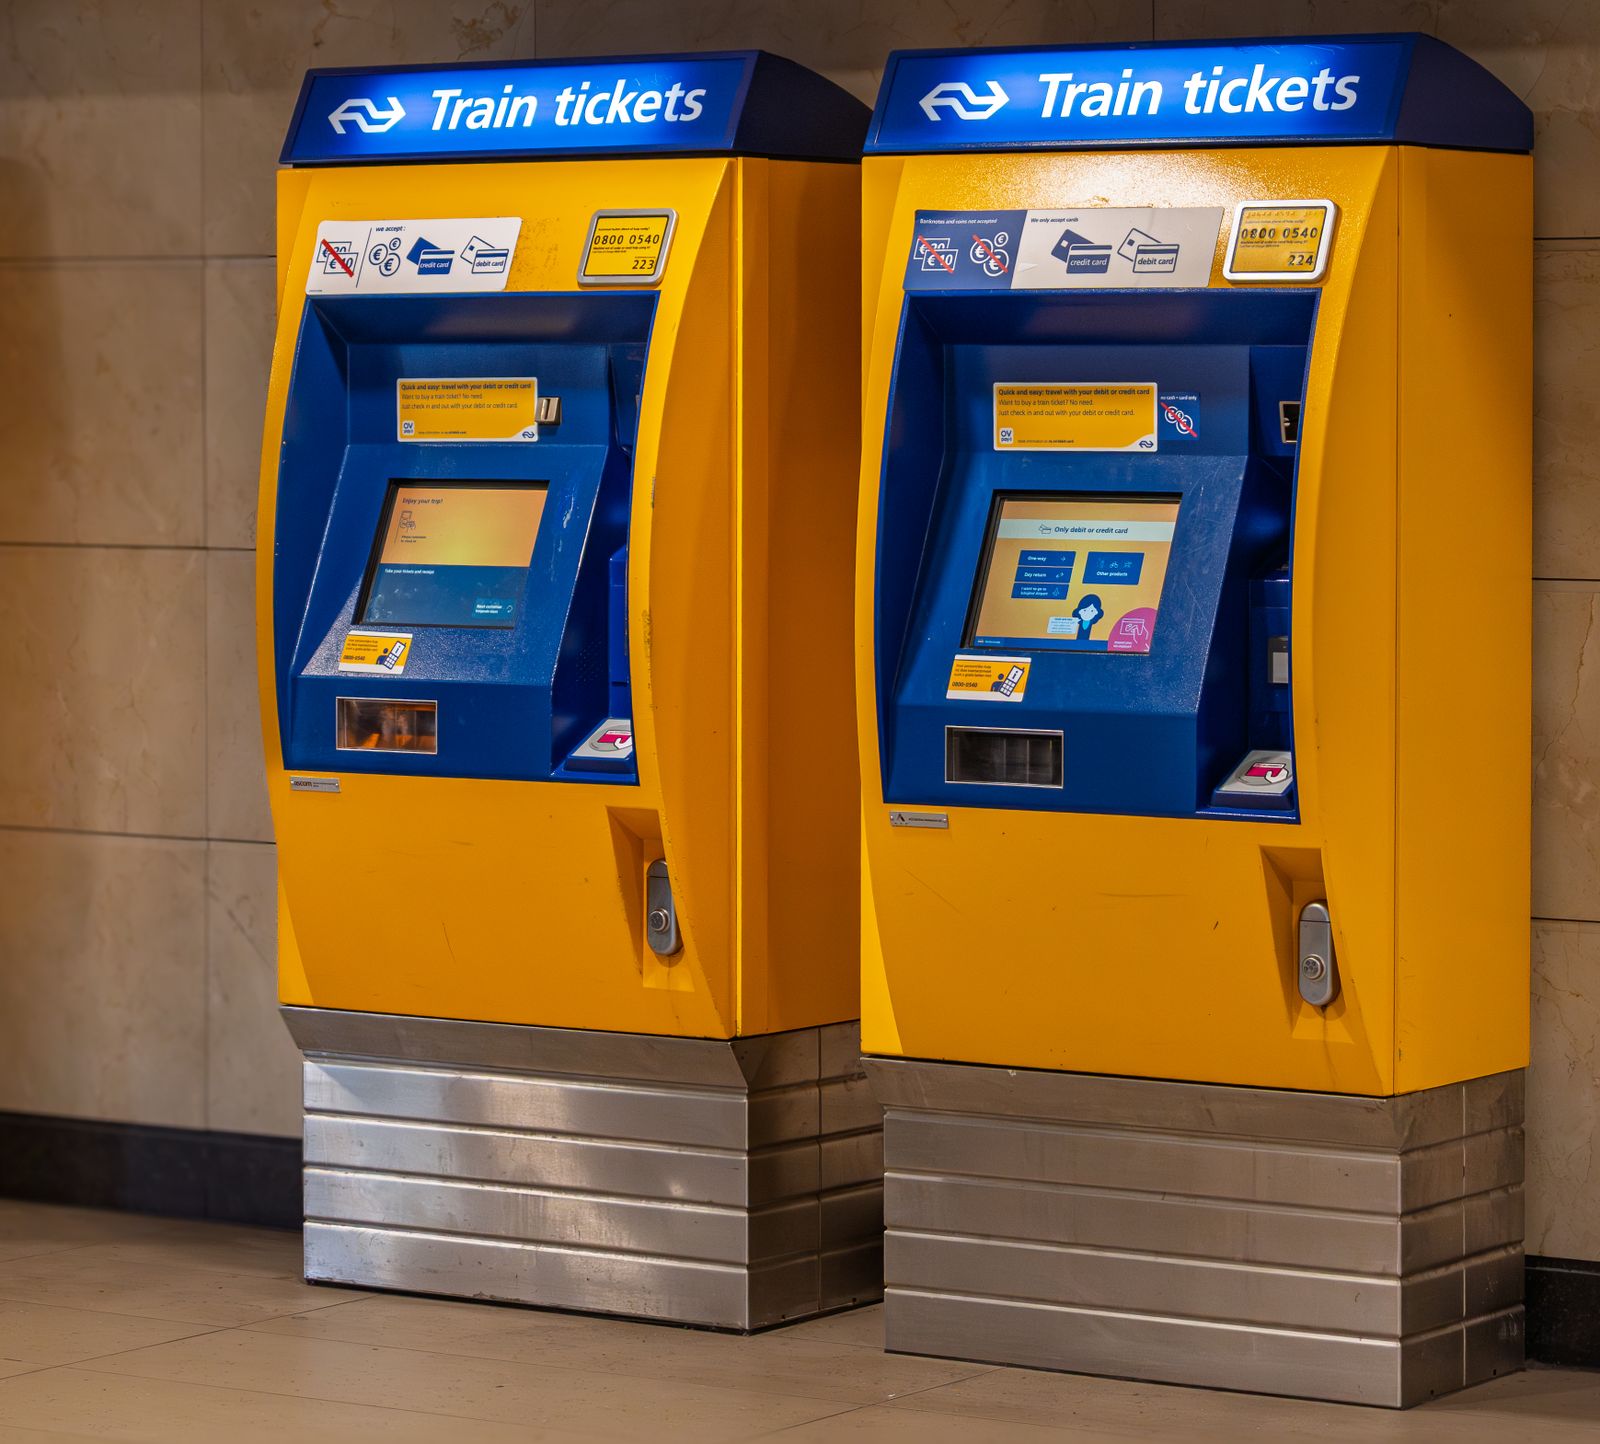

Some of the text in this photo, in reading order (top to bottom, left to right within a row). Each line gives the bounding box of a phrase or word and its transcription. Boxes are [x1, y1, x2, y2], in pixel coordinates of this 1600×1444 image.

[1038, 63, 1360, 119] Train tickets
[430, 78, 707, 131] Train tickets
[1242, 227, 1318, 239] 0800 0540
[594, 234, 659, 245] 0800 0540
[632, 260, 654, 269] 223
[1288, 255, 1313, 266] 224
